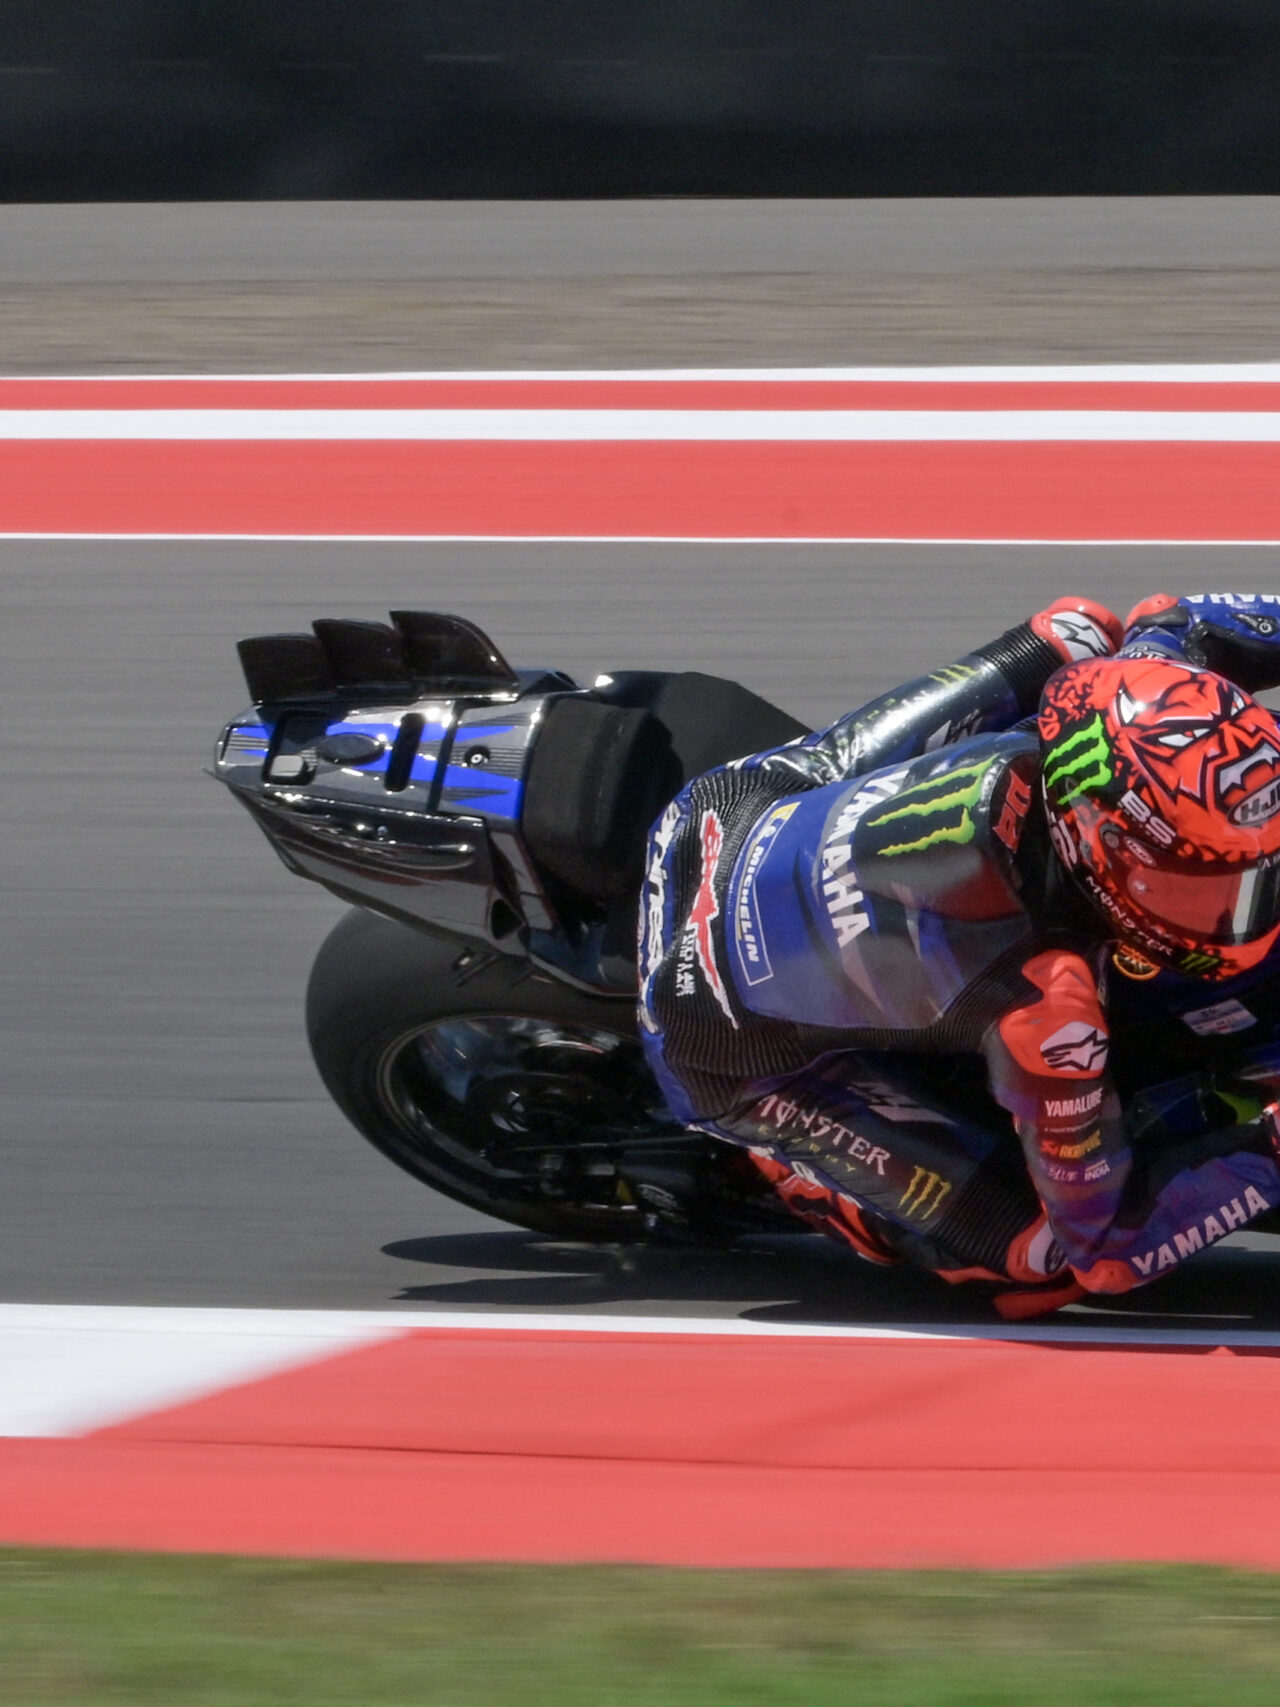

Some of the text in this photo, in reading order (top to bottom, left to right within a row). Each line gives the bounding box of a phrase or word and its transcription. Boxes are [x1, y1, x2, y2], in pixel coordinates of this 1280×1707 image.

[822, 769, 910, 948] YAMAHA
[1120, 789, 1177, 845] BS
[739, 845, 765, 963] MICHELIN
[1131, 1184, 1271, 1280] YAMAHA
